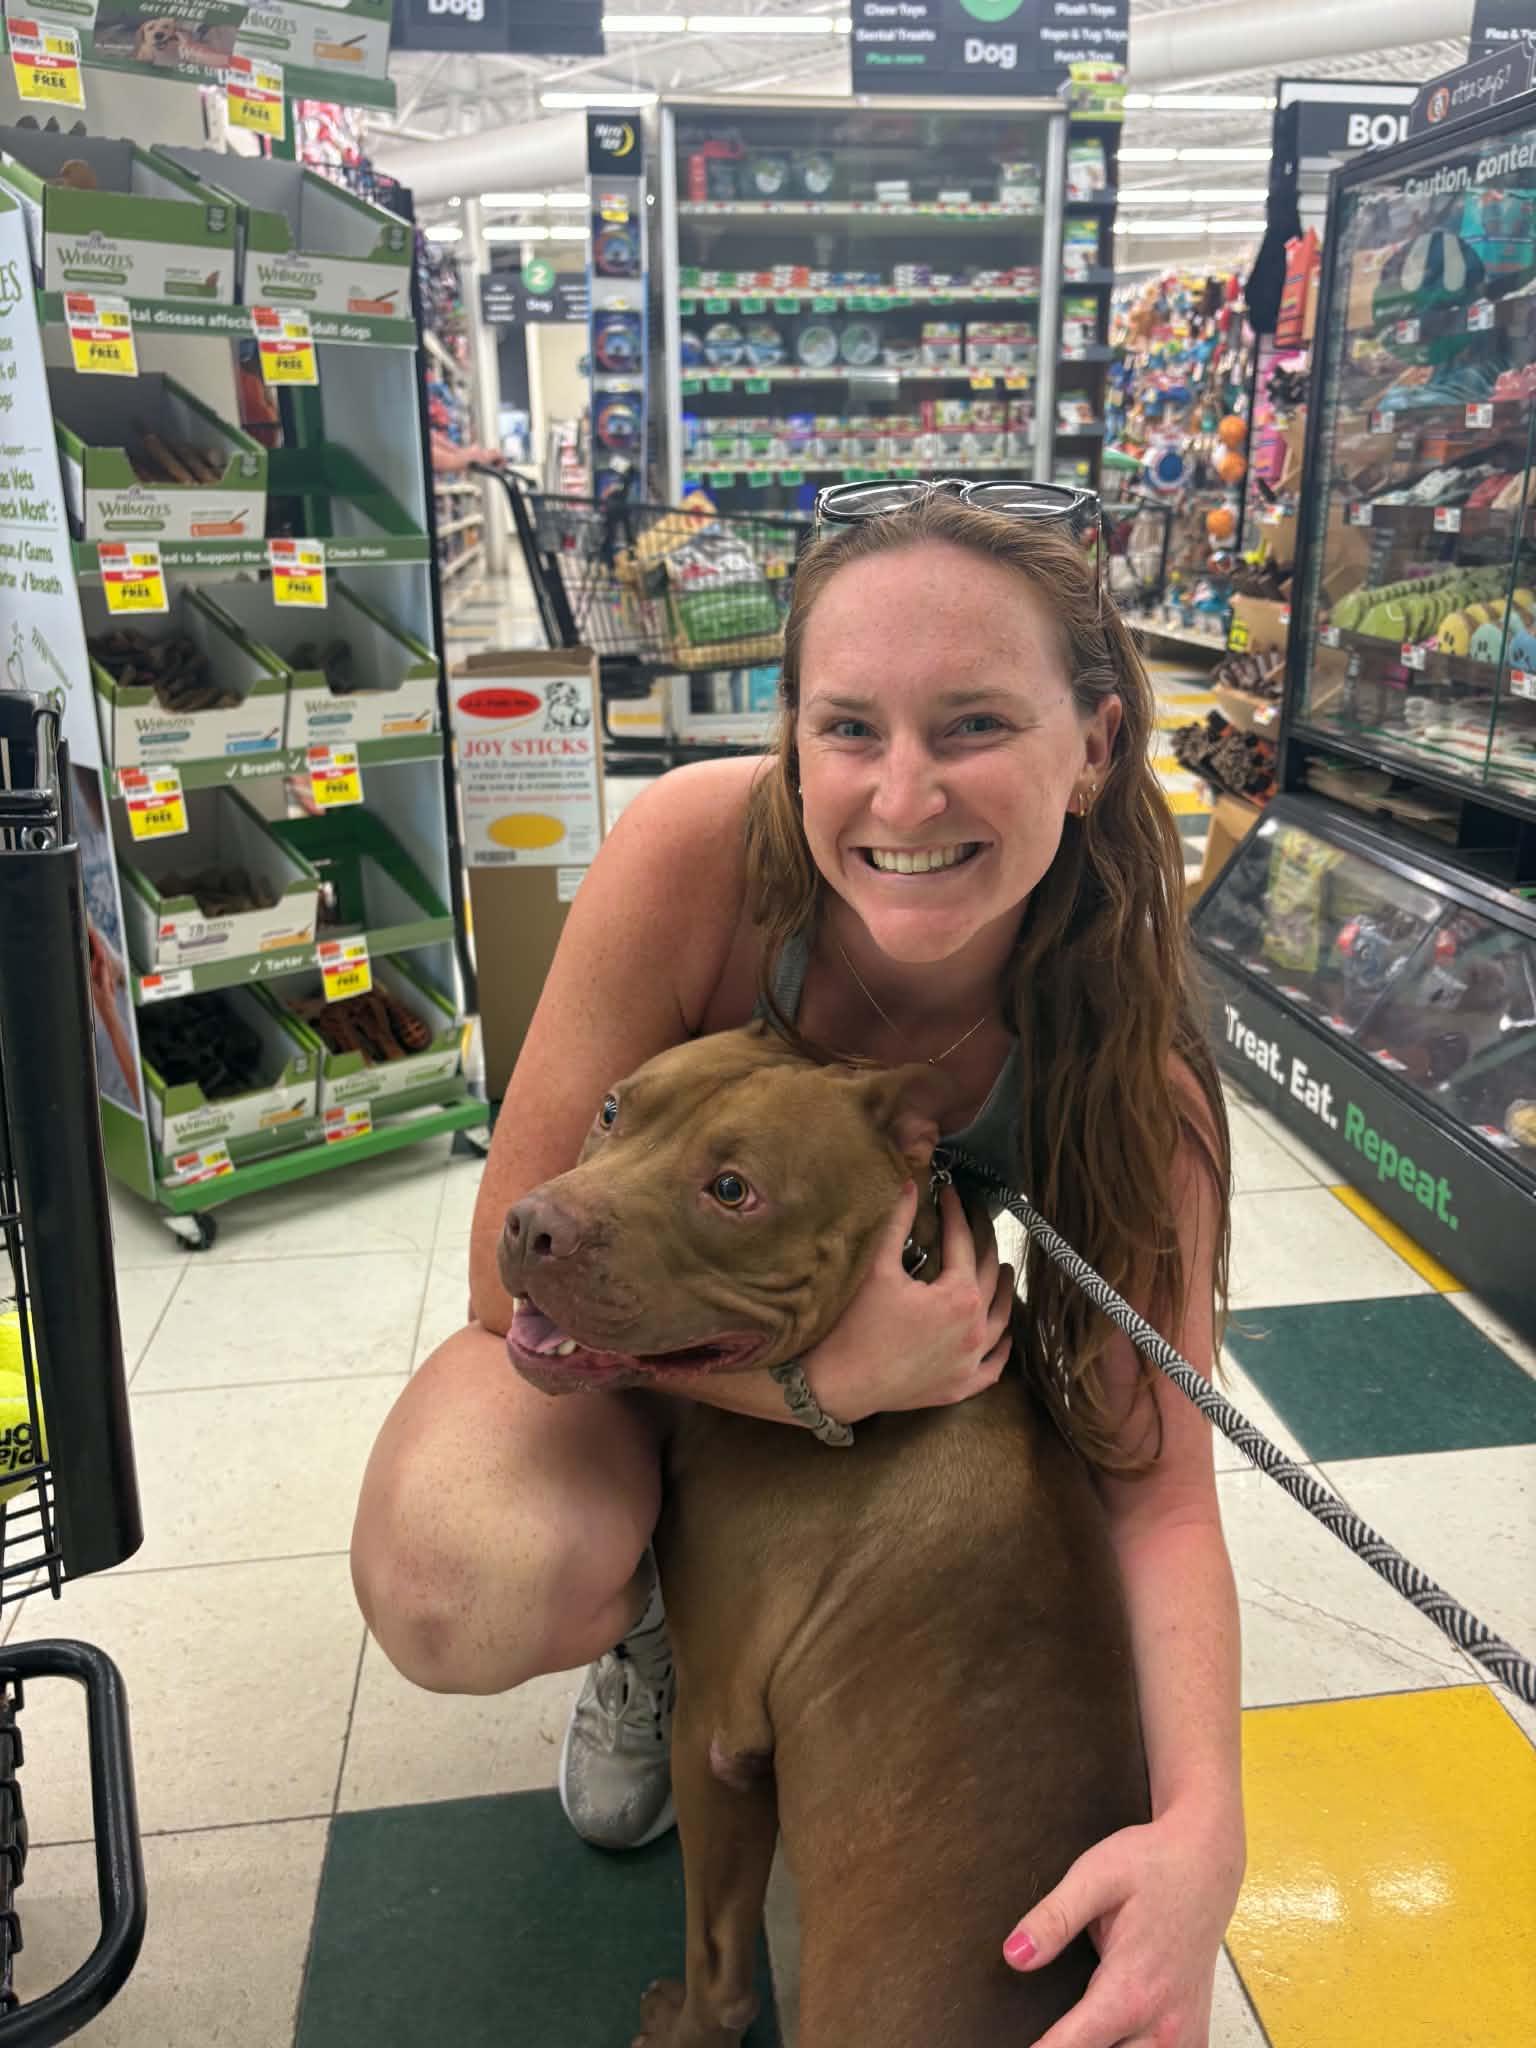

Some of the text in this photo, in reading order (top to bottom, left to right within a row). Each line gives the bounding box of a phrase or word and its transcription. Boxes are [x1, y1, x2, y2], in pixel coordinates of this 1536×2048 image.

[899, 4, 927, 19] Toys
[1089, 4, 1116, 18] Toys
[965, 39, 1017, 69] Dog
[33, 74, 66, 88] FREE
[1405, 166, 1472, 198] Caution,
[531, 266, 547, 286] 2
[153, 310, 206, 327] disease
[341, 324, 371, 340] dogs
[89, 344, 121, 359] FREE
[196, 549, 241, 565] Support
[328, 548, 358, 560] Check
[121, 585, 151, 599] FREE
[463, 738, 590, 758] JOY STICKS
[241, 761, 286, 777] Breath
[1225, 1003, 1458, 1231] Treat. Eat. Repeat.
